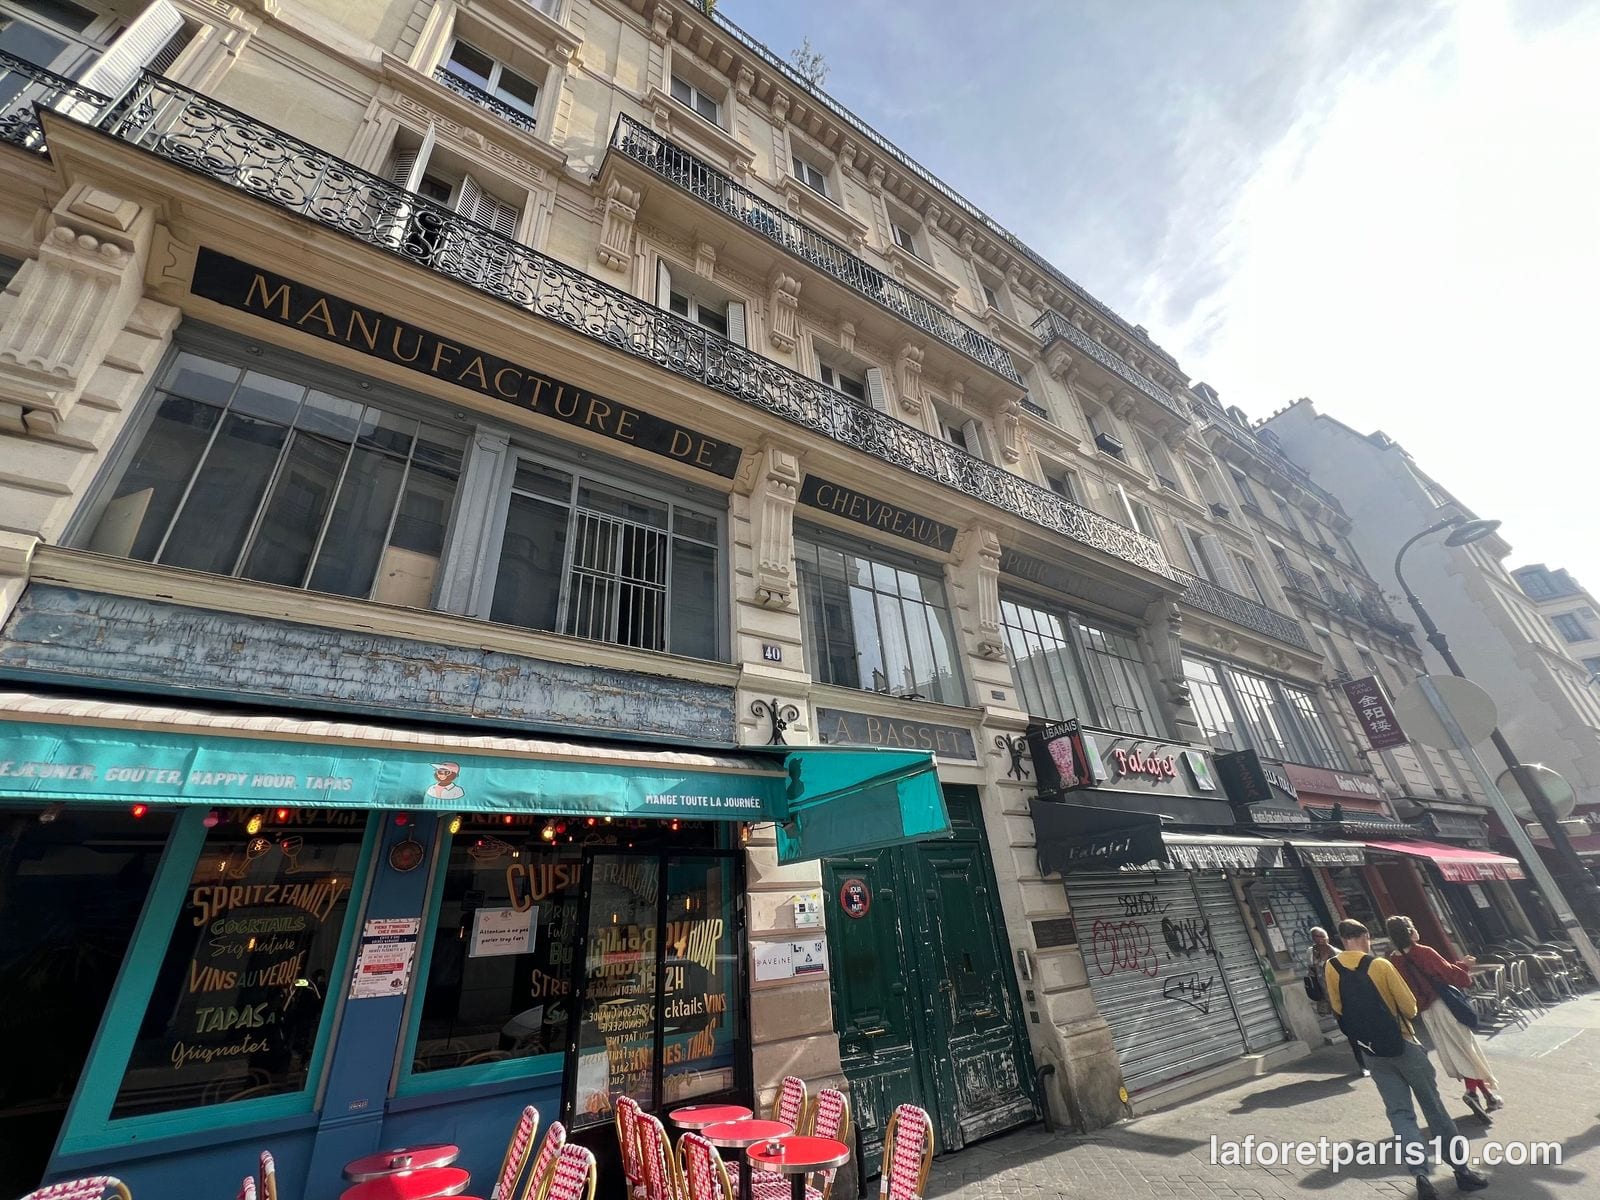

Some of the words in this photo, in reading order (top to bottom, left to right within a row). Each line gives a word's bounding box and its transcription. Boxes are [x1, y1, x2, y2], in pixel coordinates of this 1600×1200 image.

[243, 274, 641, 440] MANUFACTURE
[669, 429, 717, 467] DE
[816, 485, 947, 547] CHEVREAUX
[765, 646, 780, 660] 40
[835, 716, 852, 742] A
[866, 717, 961, 753] BASSET
[1042, 720, 1077, 741] LIBANAIS
[191, 770, 248, 787] HAPPY
[305, 776, 353, 791] TAPAS
[1115, 748, 1177, 781] Falafel
[645, 794, 678, 806] MANGE
[680, 795, 709, 807] TOUTE
[710, 797, 722, 807] LA
[723, 796, 761, 808] JOURNÉE
[192, 884, 275, 927] SPRITZ
[280, 883, 343, 923] FAMILY
[211, 916, 306, 935] COCKTAILS
[209, 933, 295, 959] Signature
[687, 918, 723, 976] HOUR
[189, 958, 237, 993] VINS
[236, 972, 257, 988] AU
[195, 1003, 268, 1034] TAPAS
[703, 992, 727, 1013] VINS
[171, 1034, 269, 1070] Grignoter
[687, 1017, 716, 1061] TAPAS
